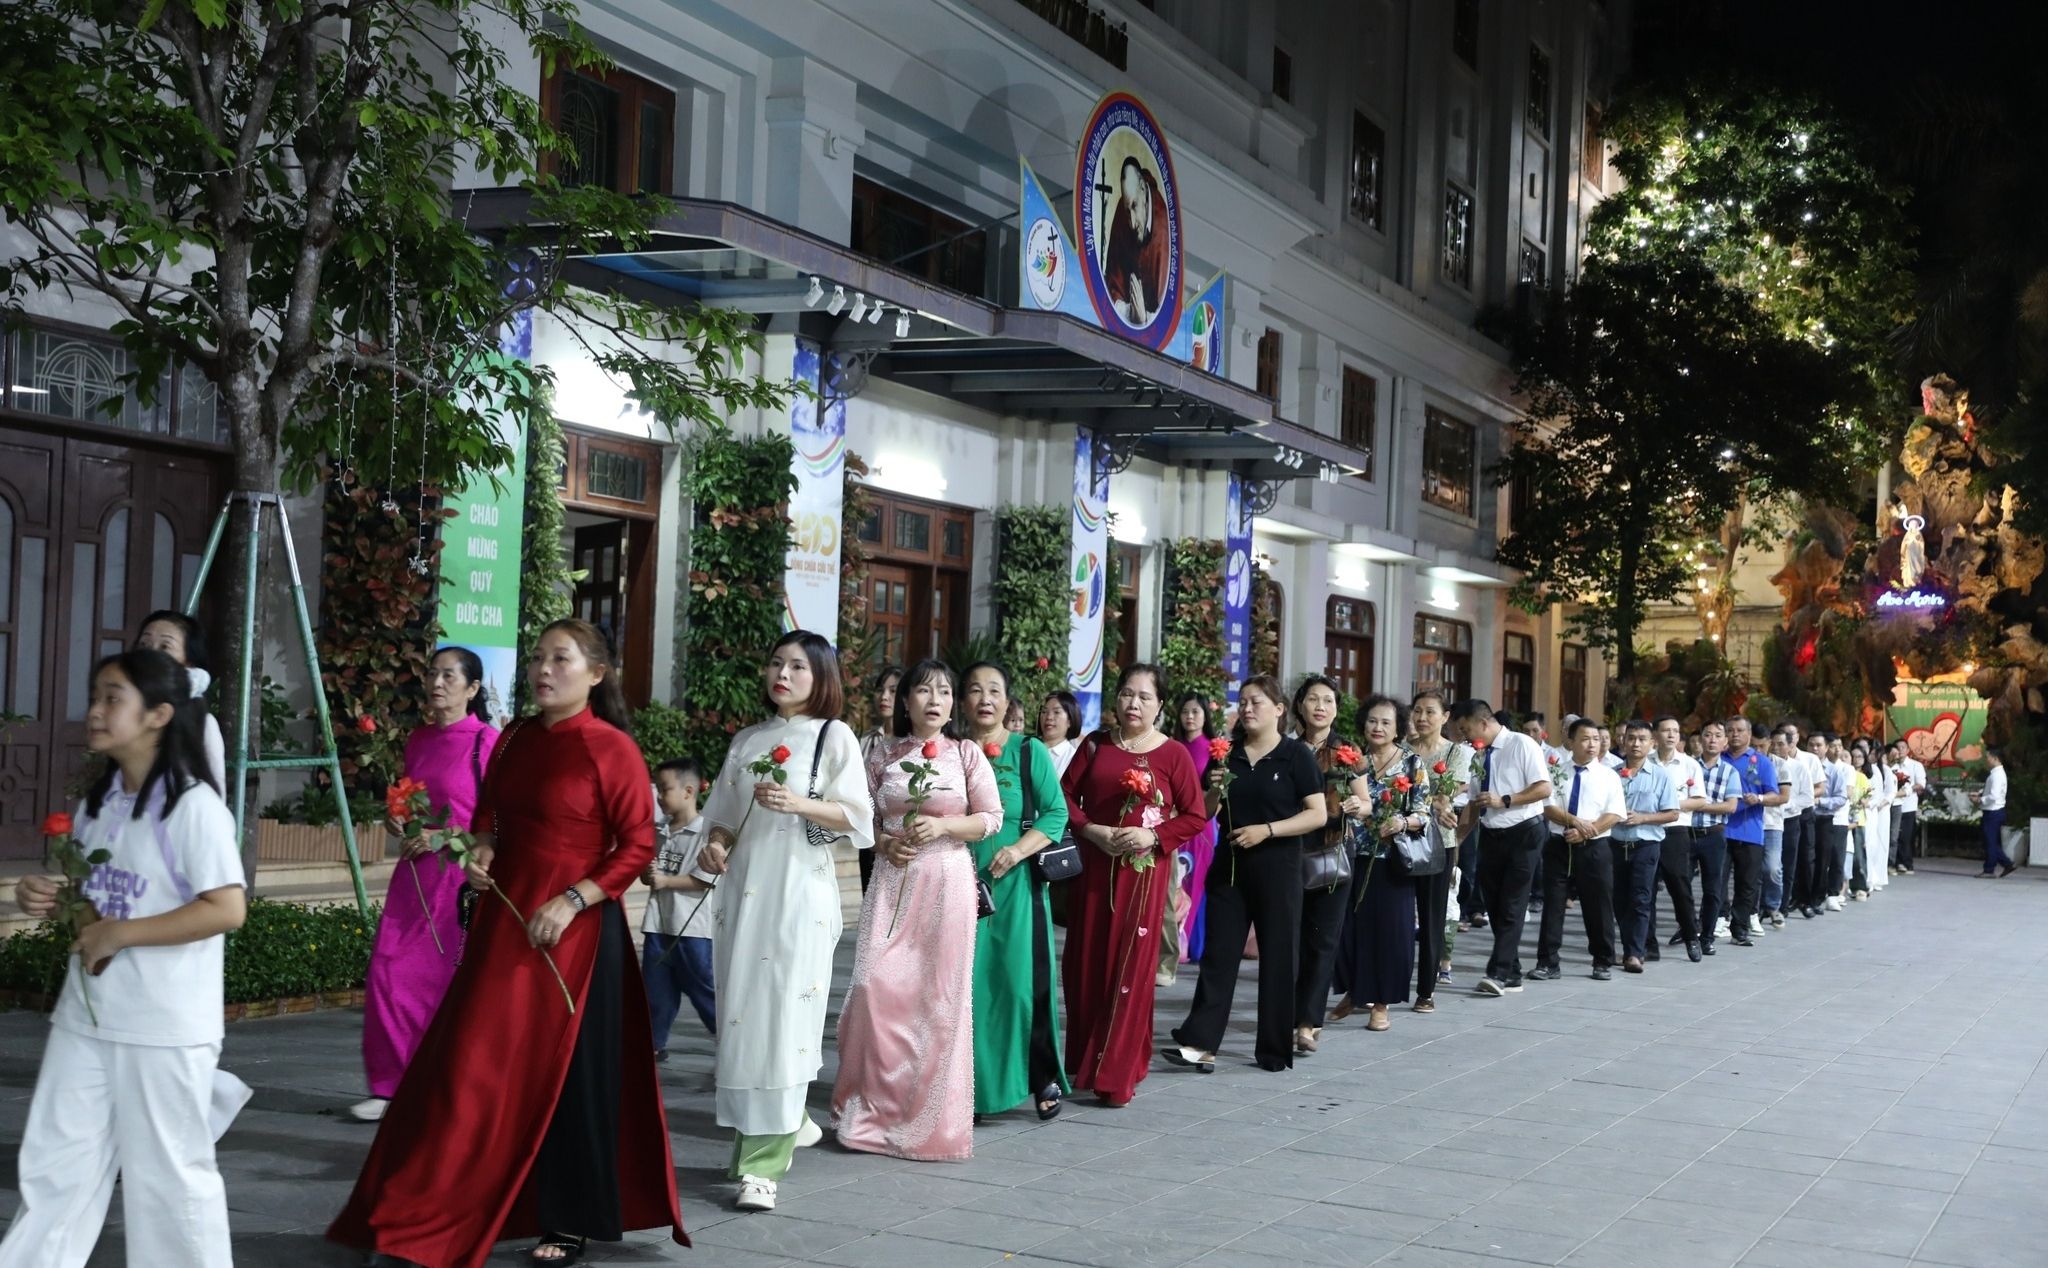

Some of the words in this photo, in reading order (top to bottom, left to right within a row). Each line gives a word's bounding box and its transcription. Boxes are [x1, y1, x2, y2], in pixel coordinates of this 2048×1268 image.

[470, 503, 499, 527] CHÀO
[467, 534, 498, 560] MỪNG
[470, 569, 493, 593] QUÝ
[456, 600, 479, 625] ĐỨC
[481, 605, 503, 628] CHA
